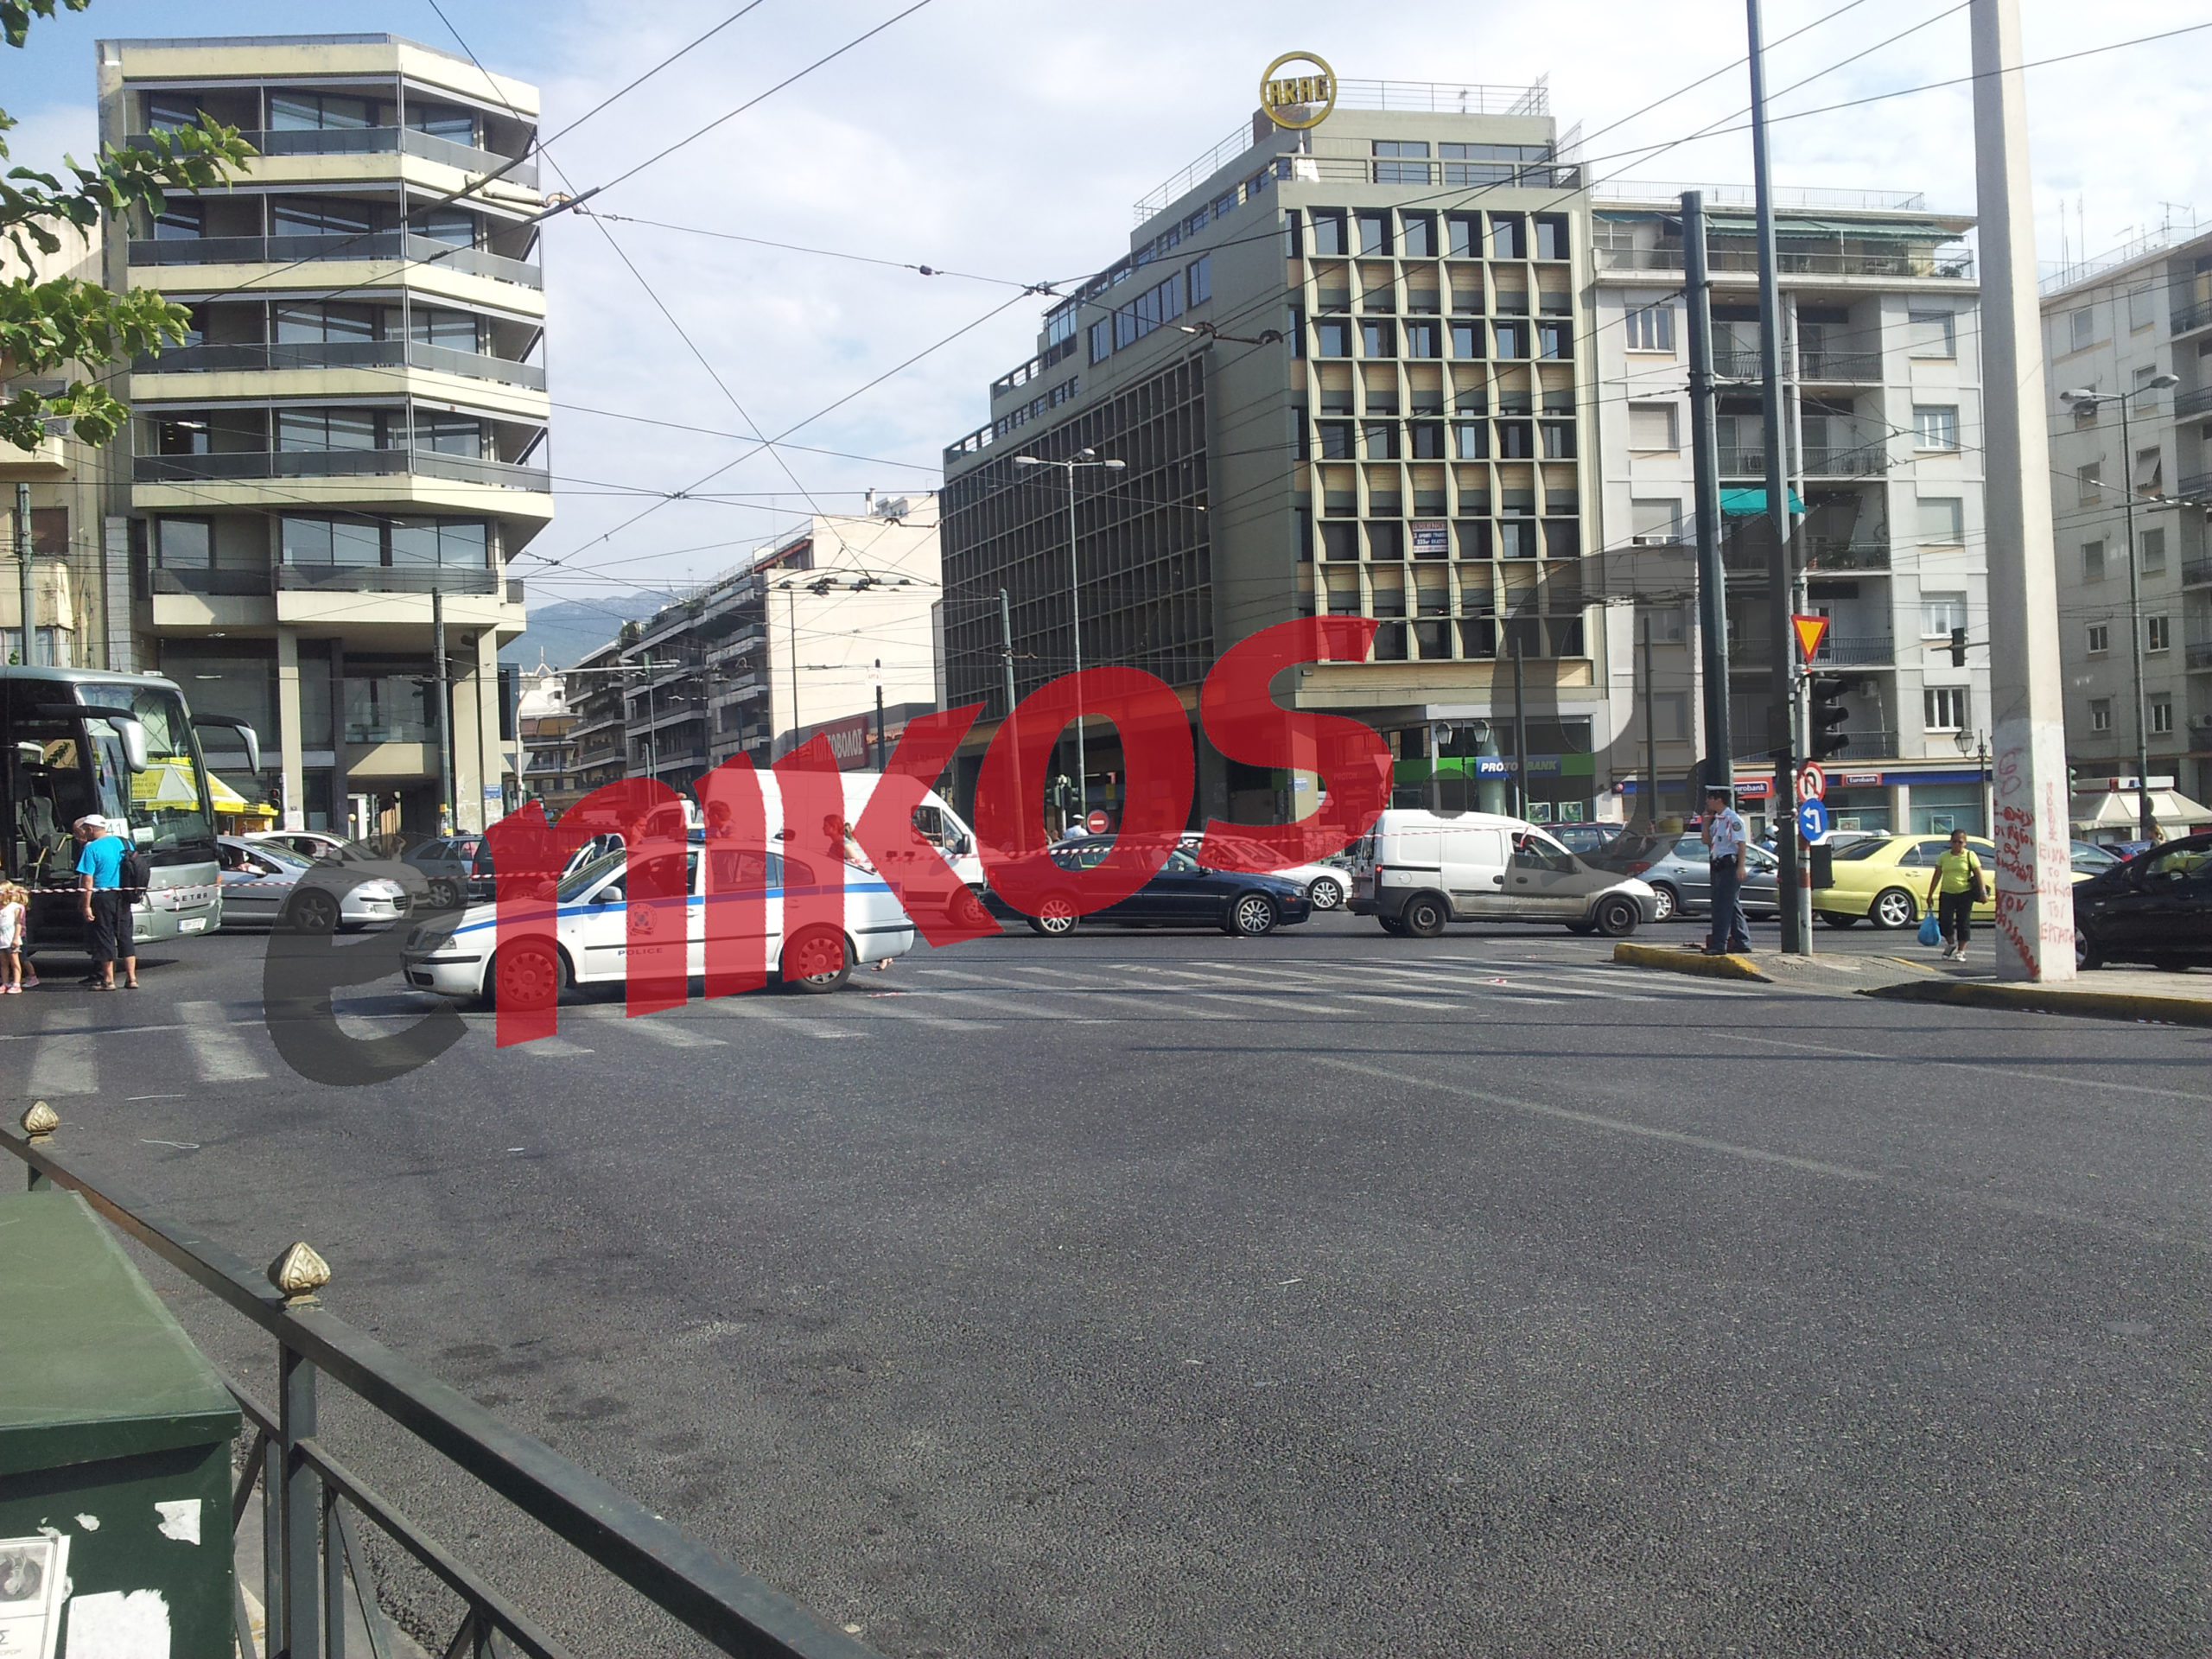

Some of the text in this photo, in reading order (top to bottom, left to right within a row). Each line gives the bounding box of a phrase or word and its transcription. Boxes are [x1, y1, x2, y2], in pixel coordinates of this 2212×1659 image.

[1268, 75, 1328, 106] ARAG
[1480, 760, 1557, 773] PROTO BANK
[1734, 783, 1766, 793] urobank
[173, 892, 208, 903] SETRA
[618, 947, 664, 956] POLICE
